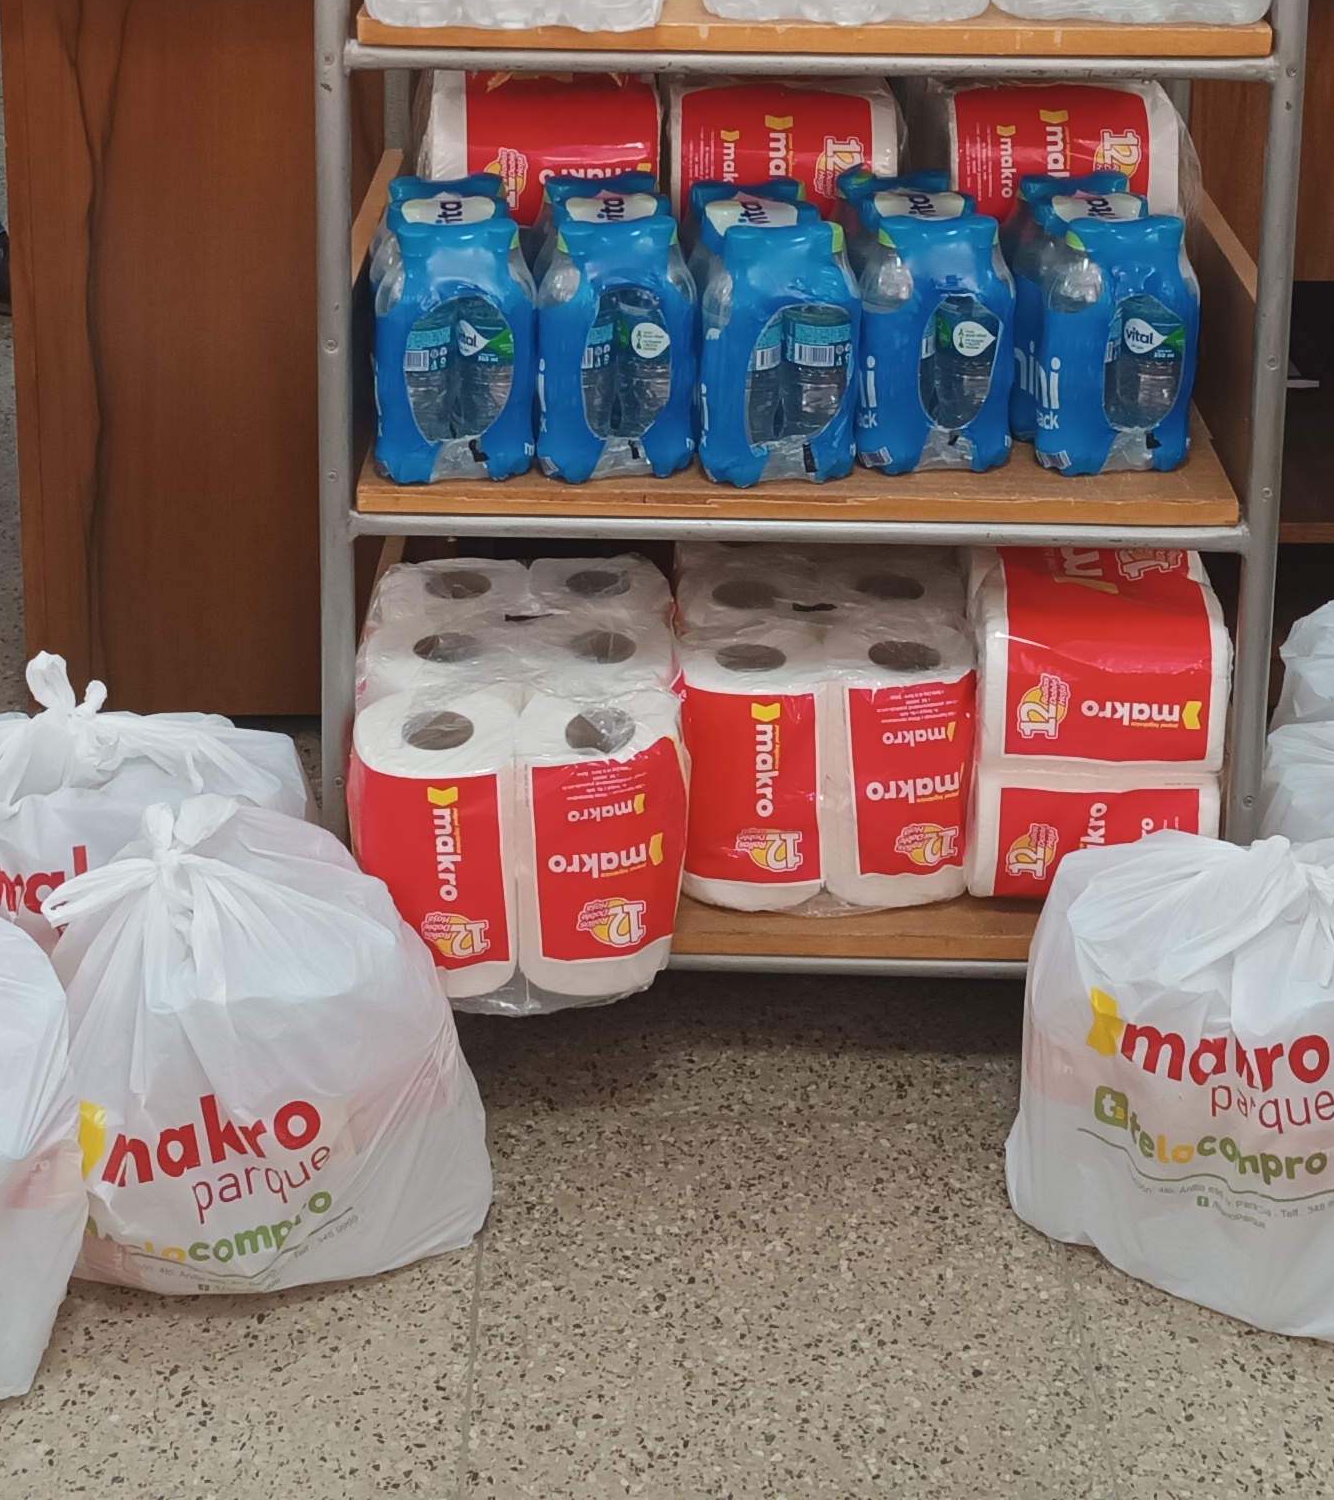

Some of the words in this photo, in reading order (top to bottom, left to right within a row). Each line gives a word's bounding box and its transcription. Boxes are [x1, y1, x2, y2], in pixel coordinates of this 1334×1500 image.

[723, 143, 738, 183] mak
[1102, 132, 1140, 167] 12
[1000, 138, 1016, 198] makro
[1126, 327, 1154, 345] vital
[1020, 702, 1056, 737] 12
[1081, 700, 1180, 726] makro
[882, 726, 946, 747] makro
[755, 724, 779, 818] makro
[866, 772, 959, 804] makro
[568, 800, 633, 822] makro
[1080, 802, 1107, 843] kro
[432, 808, 461, 901] makro
[548, 843, 647, 878] makro
[767, 832, 801, 869] 12
[924, 828, 957, 864] 12
[1009, 848, 1044, 877] 12
[452, 921, 488, 956] 12
[609, 903, 644, 945] 12
[191, 1144, 332, 1224] parque
